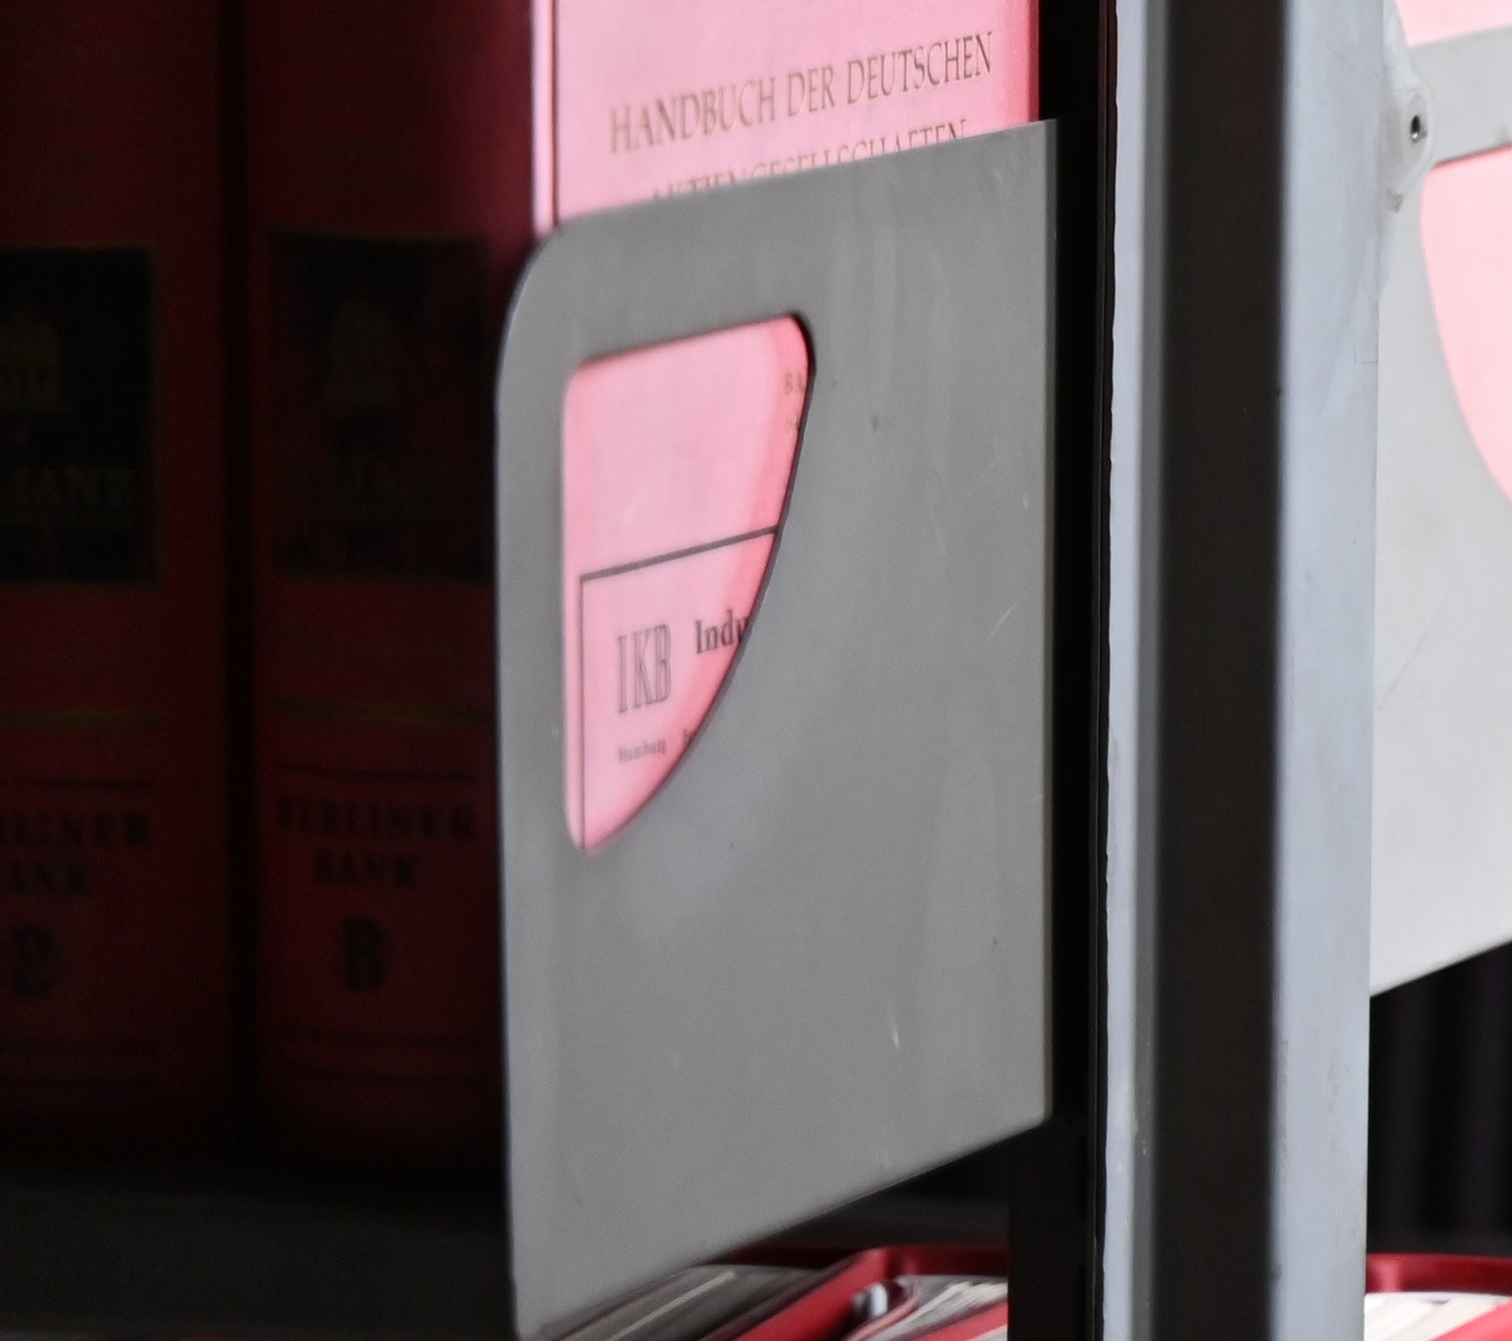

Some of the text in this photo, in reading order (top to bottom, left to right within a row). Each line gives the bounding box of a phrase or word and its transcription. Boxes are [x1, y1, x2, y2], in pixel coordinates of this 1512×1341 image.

[609, 30, 994, 154] HANDBUCH DER DEUTSCHEN
[617, 623, 672, 715] IKB
[314, 846, 422, 891] BANK
